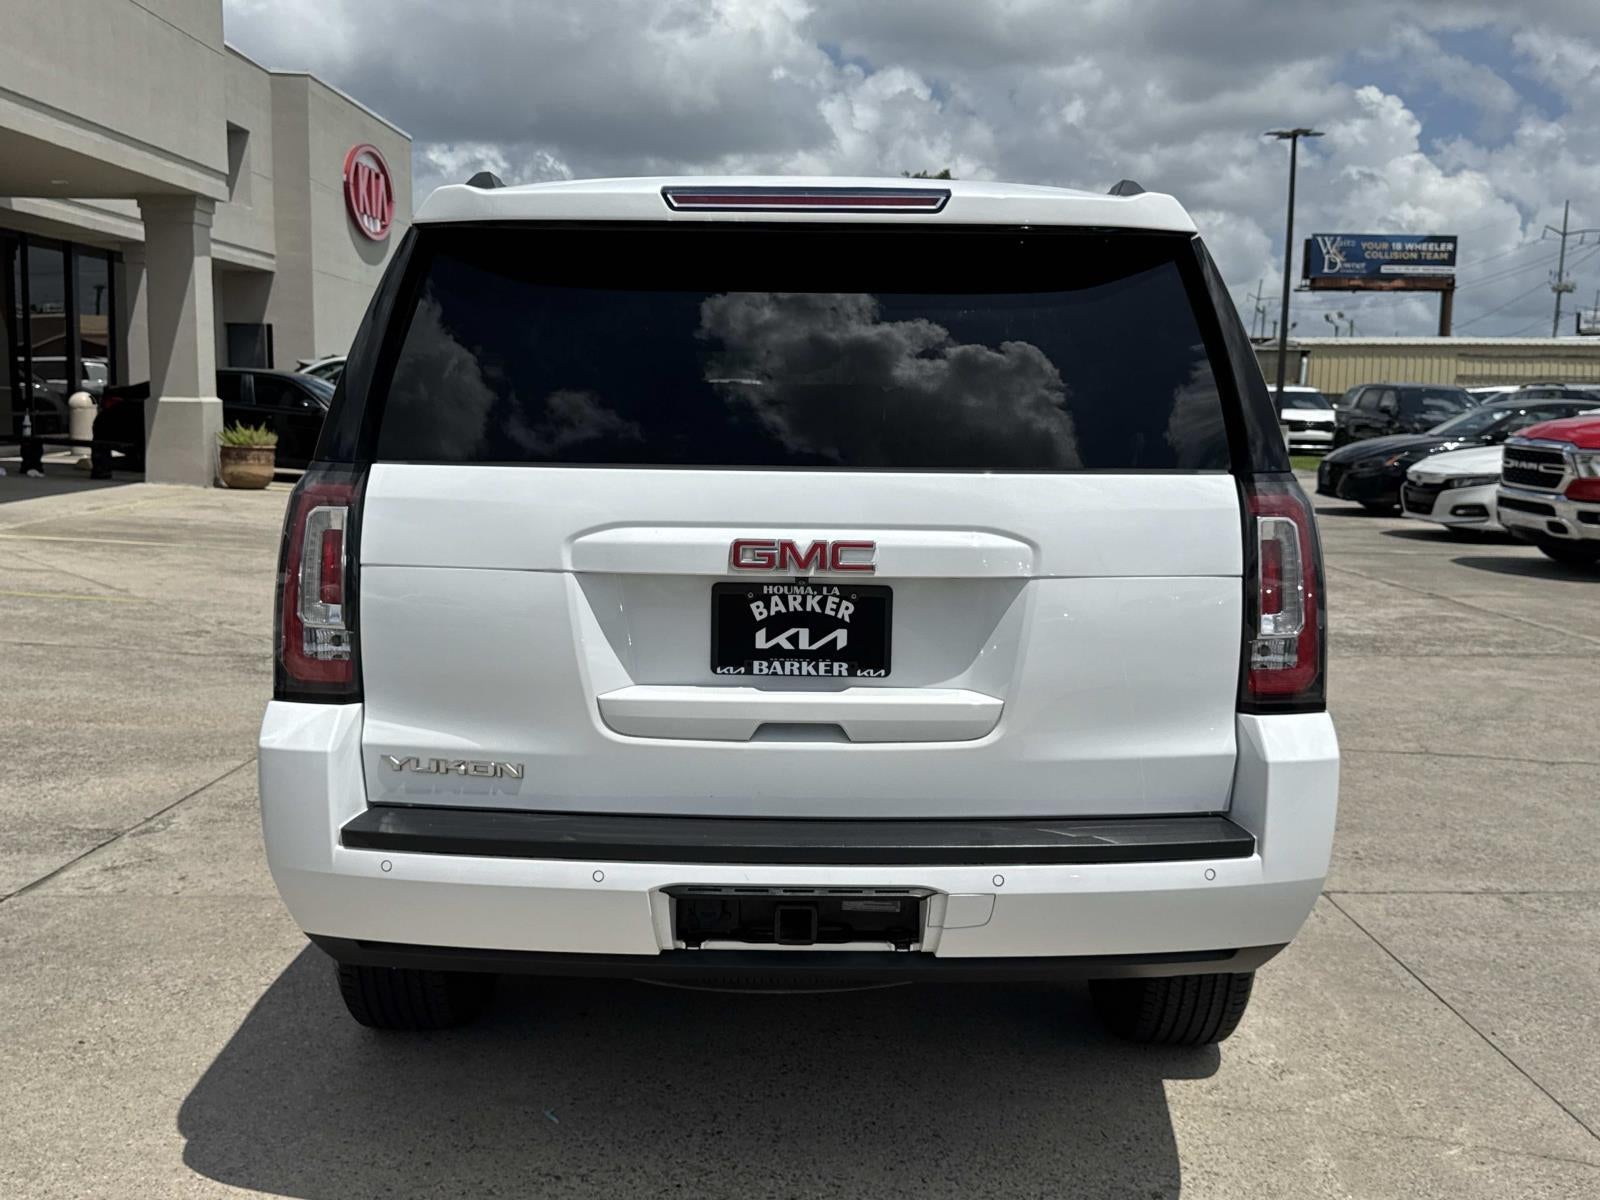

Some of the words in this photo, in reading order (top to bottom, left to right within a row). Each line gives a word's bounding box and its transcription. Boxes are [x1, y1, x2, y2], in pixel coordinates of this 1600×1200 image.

[357, 162, 389, 224] KIA
[1361, 242, 1389, 250] YOUR
[1392, 242, 1402, 250] 18
[1405, 242, 1455, 251] WHEELER
[1364, 251, 1419, 260] COLLISION
[1421, 251, 1449, 260] TEAM
[730, 538, 877, 572] GMC
[822, 586, 840, 596] LA
[750, 594, 855, 623] BARKER
[755, 627, 848, 651] KIA
[752, 660, 849, 676] BARKER
[380, 754, 524, 779] YUKON
